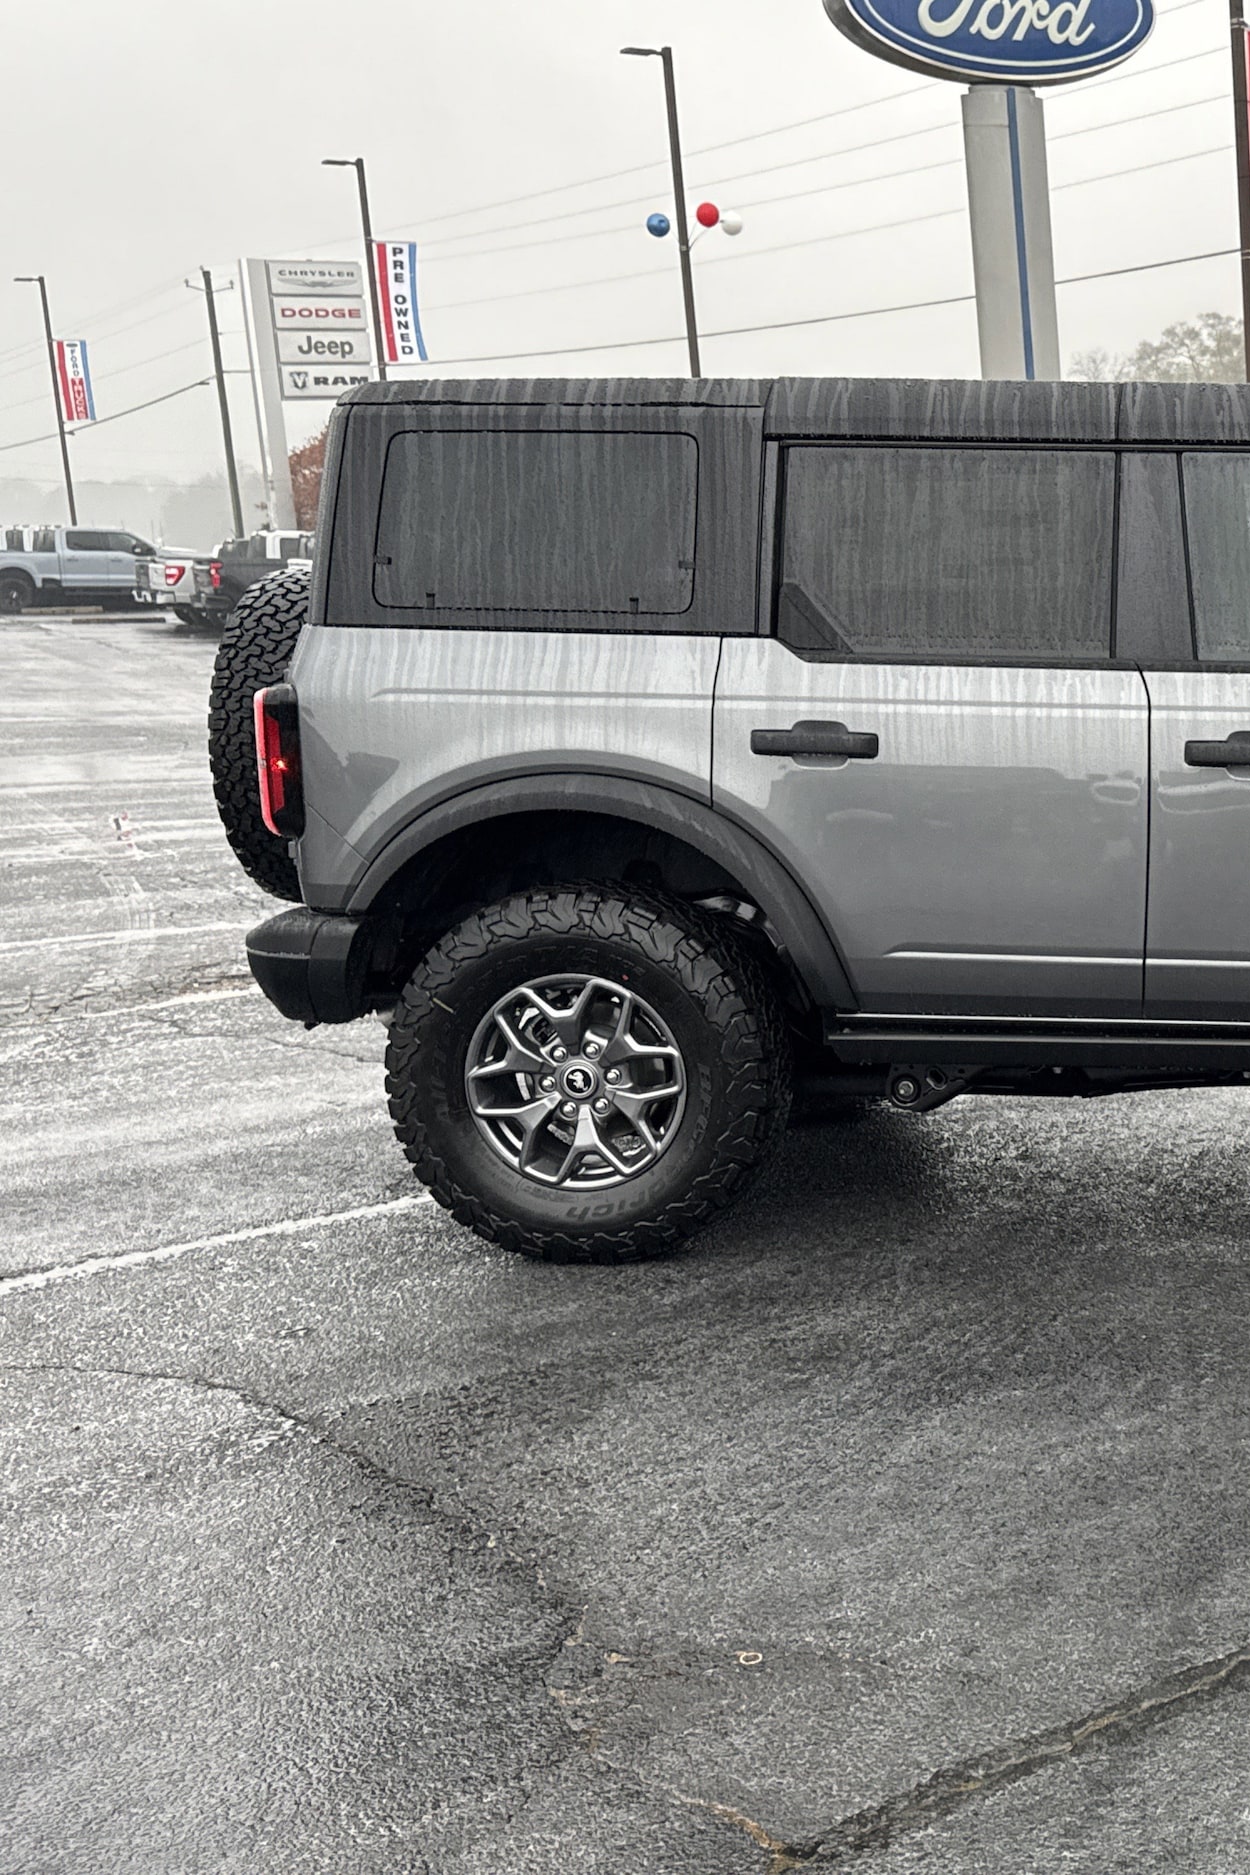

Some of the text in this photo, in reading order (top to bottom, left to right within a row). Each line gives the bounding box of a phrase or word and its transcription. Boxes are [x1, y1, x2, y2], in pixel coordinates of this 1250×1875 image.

[278, 269, 355, 278] CHRYSLER
[391, 247, 415, 356] PRE OWNED
[280, 307, 362, 319] DODGE
[297, 335, 354, 359] Jeep
[313, 376, 369, 386] RAM
